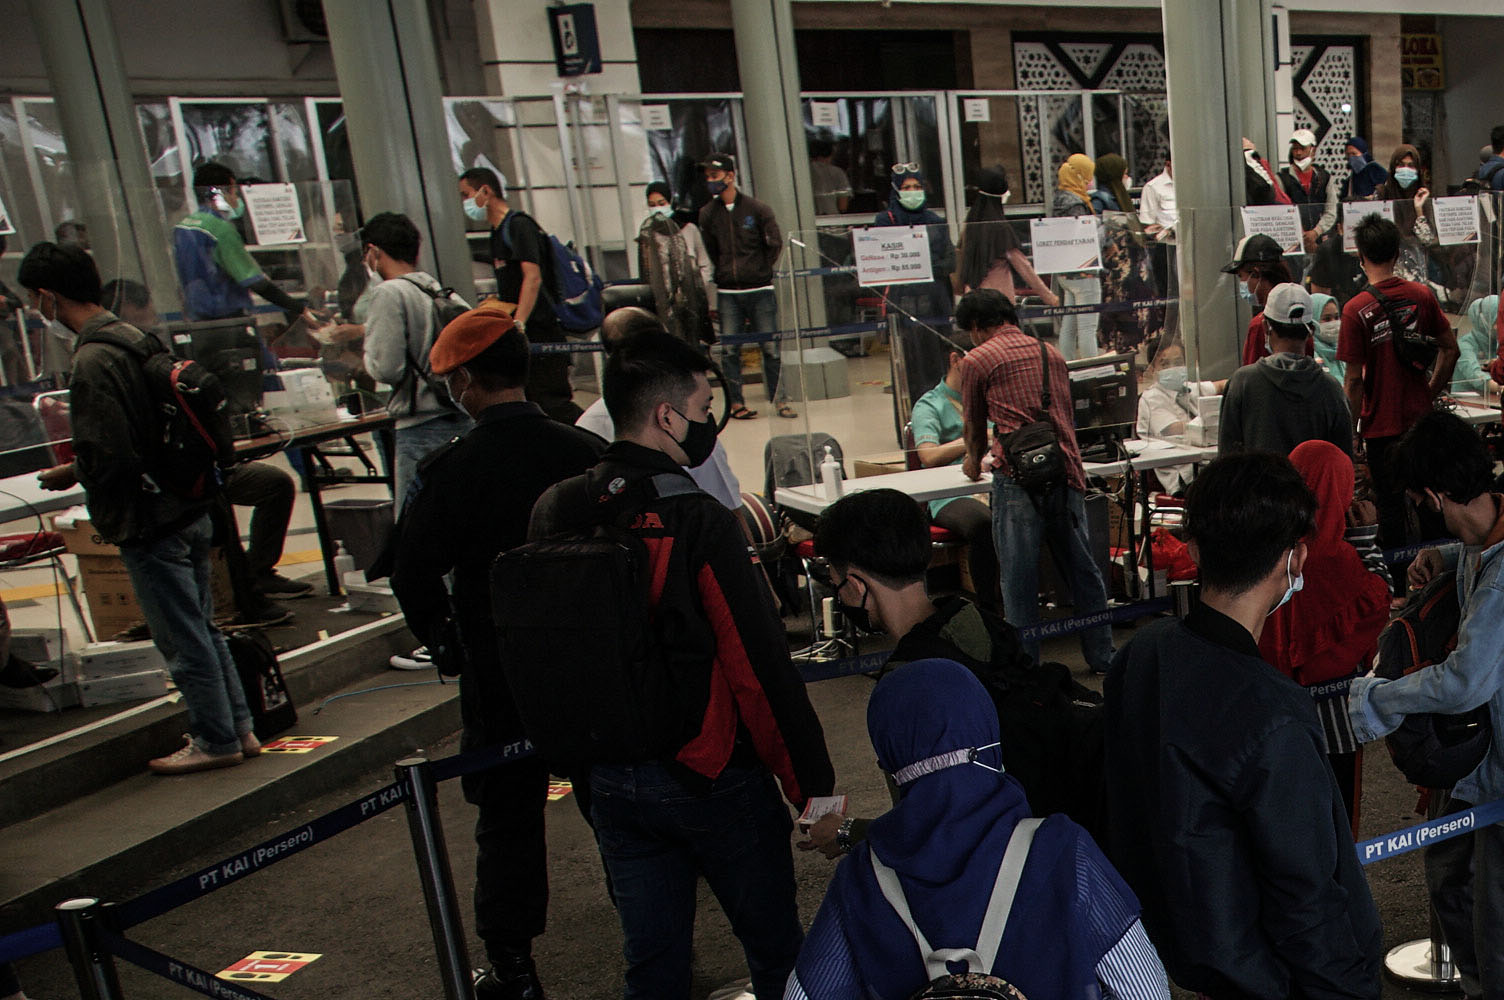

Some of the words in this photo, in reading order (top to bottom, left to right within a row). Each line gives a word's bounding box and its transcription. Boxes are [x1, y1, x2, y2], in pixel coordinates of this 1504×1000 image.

[881, 242, 905, 250] KASIR
[1022, 628, 1037, 640] PT
[1040, 621, 1061, 635] KAI
[1063, 611, 1114, 632] (Persero)
[503, 740, 520, 758] PT
[360, 798, 377, 815] PT
[380, 787, 404, 807] KAI
[1365, 842, 1385, 859] PT
[1387, 832, 1412, 852] KAI
[1415, 811, 1475, 846] (Persero)
[199, 873, 219, 890] PT
[222, 859, 250, 880] KAI
[253, 827, 314, 868] (Persero)
[168, 961, 184, 977] PT
[185, 967, 207, 990] KAI
